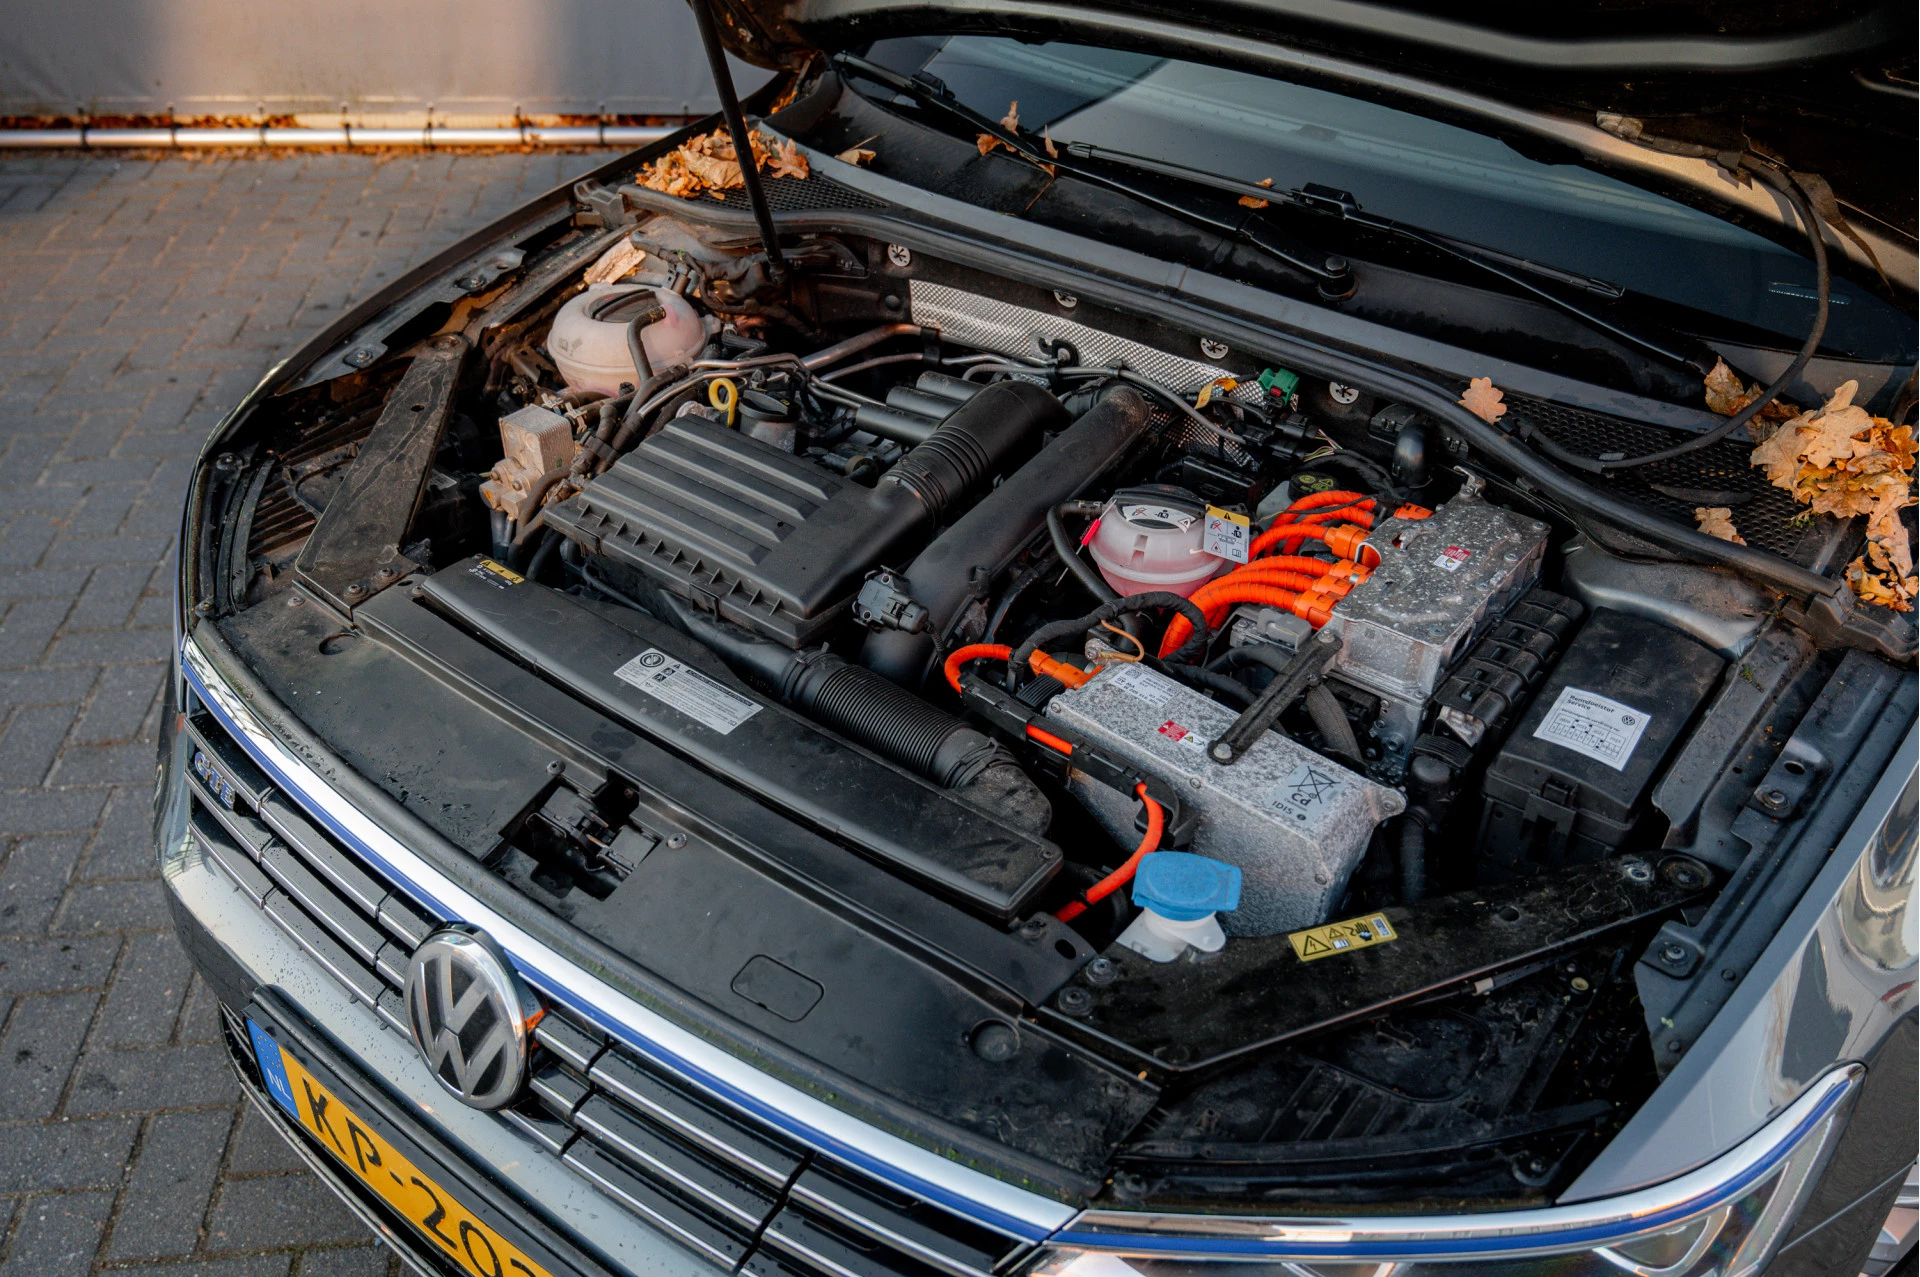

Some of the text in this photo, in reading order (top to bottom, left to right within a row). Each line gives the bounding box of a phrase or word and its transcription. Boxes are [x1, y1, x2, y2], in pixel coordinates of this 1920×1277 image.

[1567, 700, 1591, 710] Service
[195, 752, 236, 810] GTE
[1291, 793, 1312, 806] Cd
[1272, 800, 1294, 814] IDIS
[267, 1068, 291, 1101] NL
